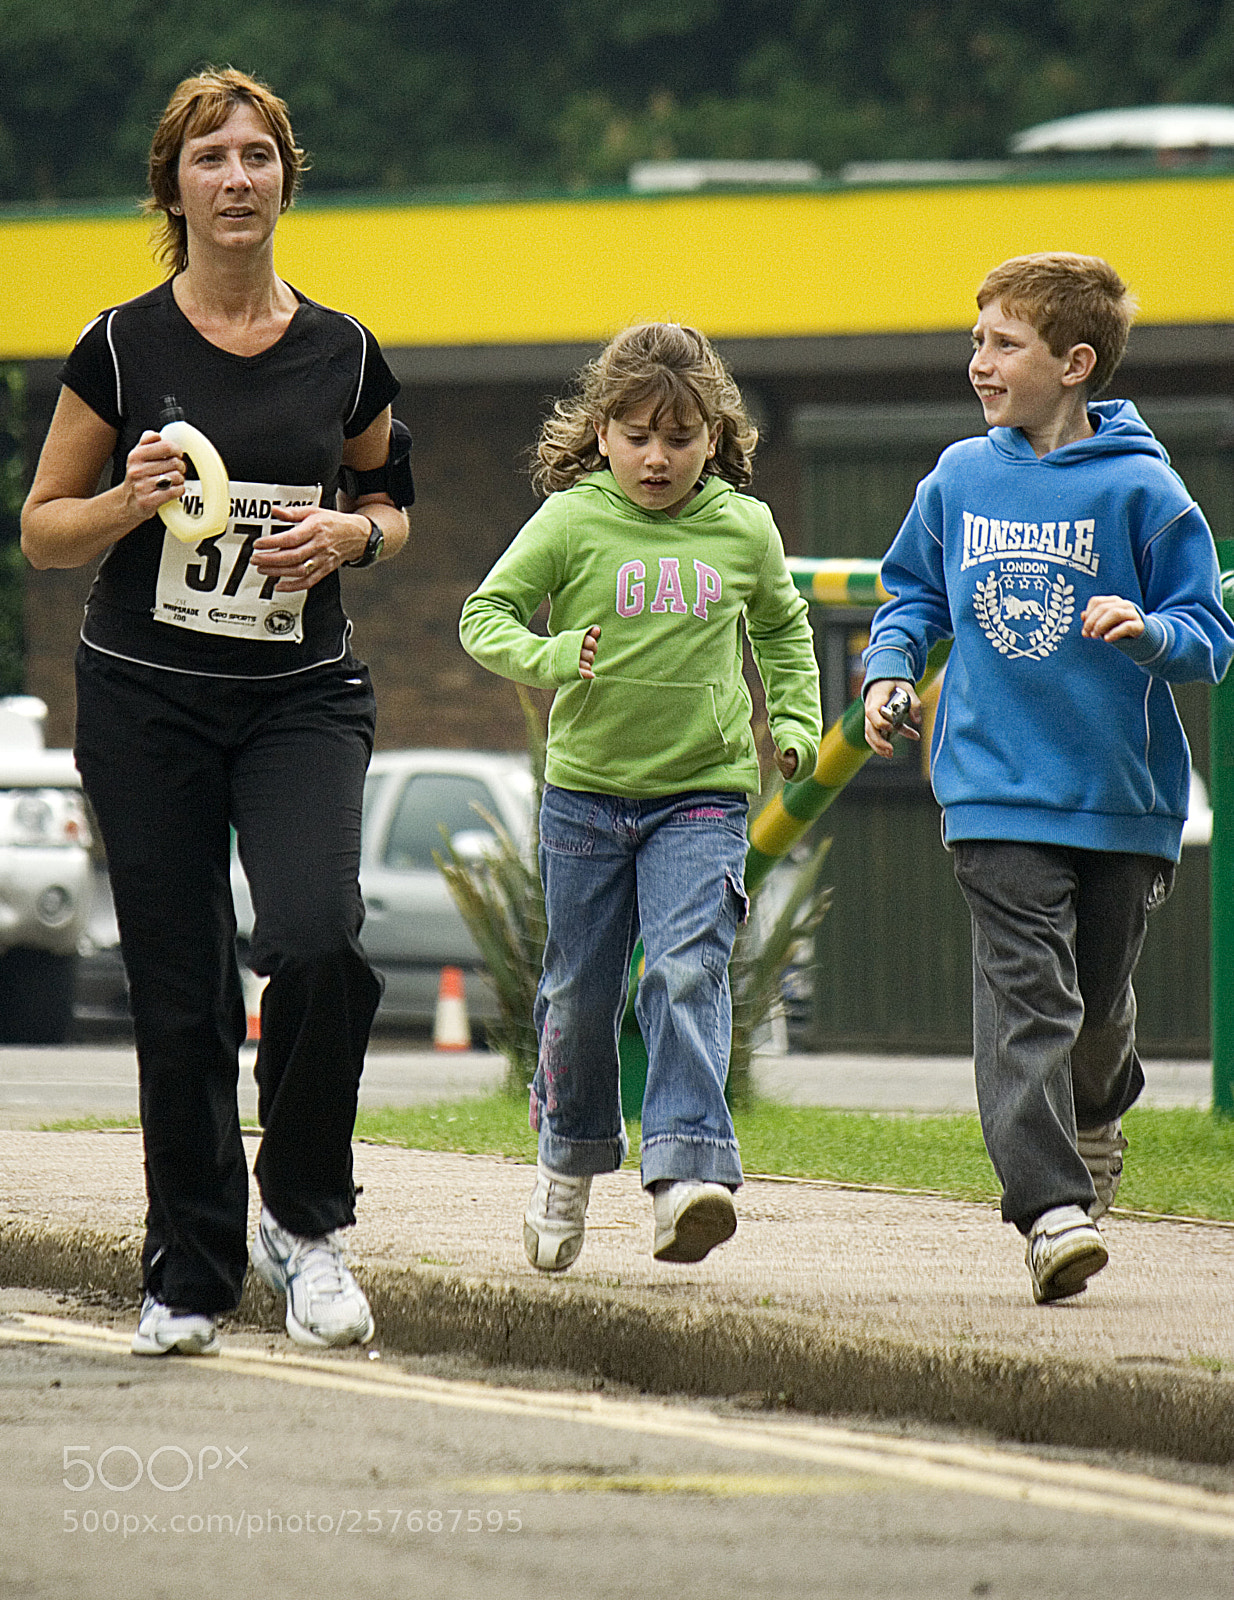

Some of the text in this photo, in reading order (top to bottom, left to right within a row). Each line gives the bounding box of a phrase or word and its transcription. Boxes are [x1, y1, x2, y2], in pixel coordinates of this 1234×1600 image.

[961, 511, 1097, 571] LONSDALE
[1000, 561, 1049, 574] LONDON
[616, 557, 722, 621] GAP
[163, 602, 199, 616] WHIPSNADE
[229, 613, 257, 623] SPORTS
